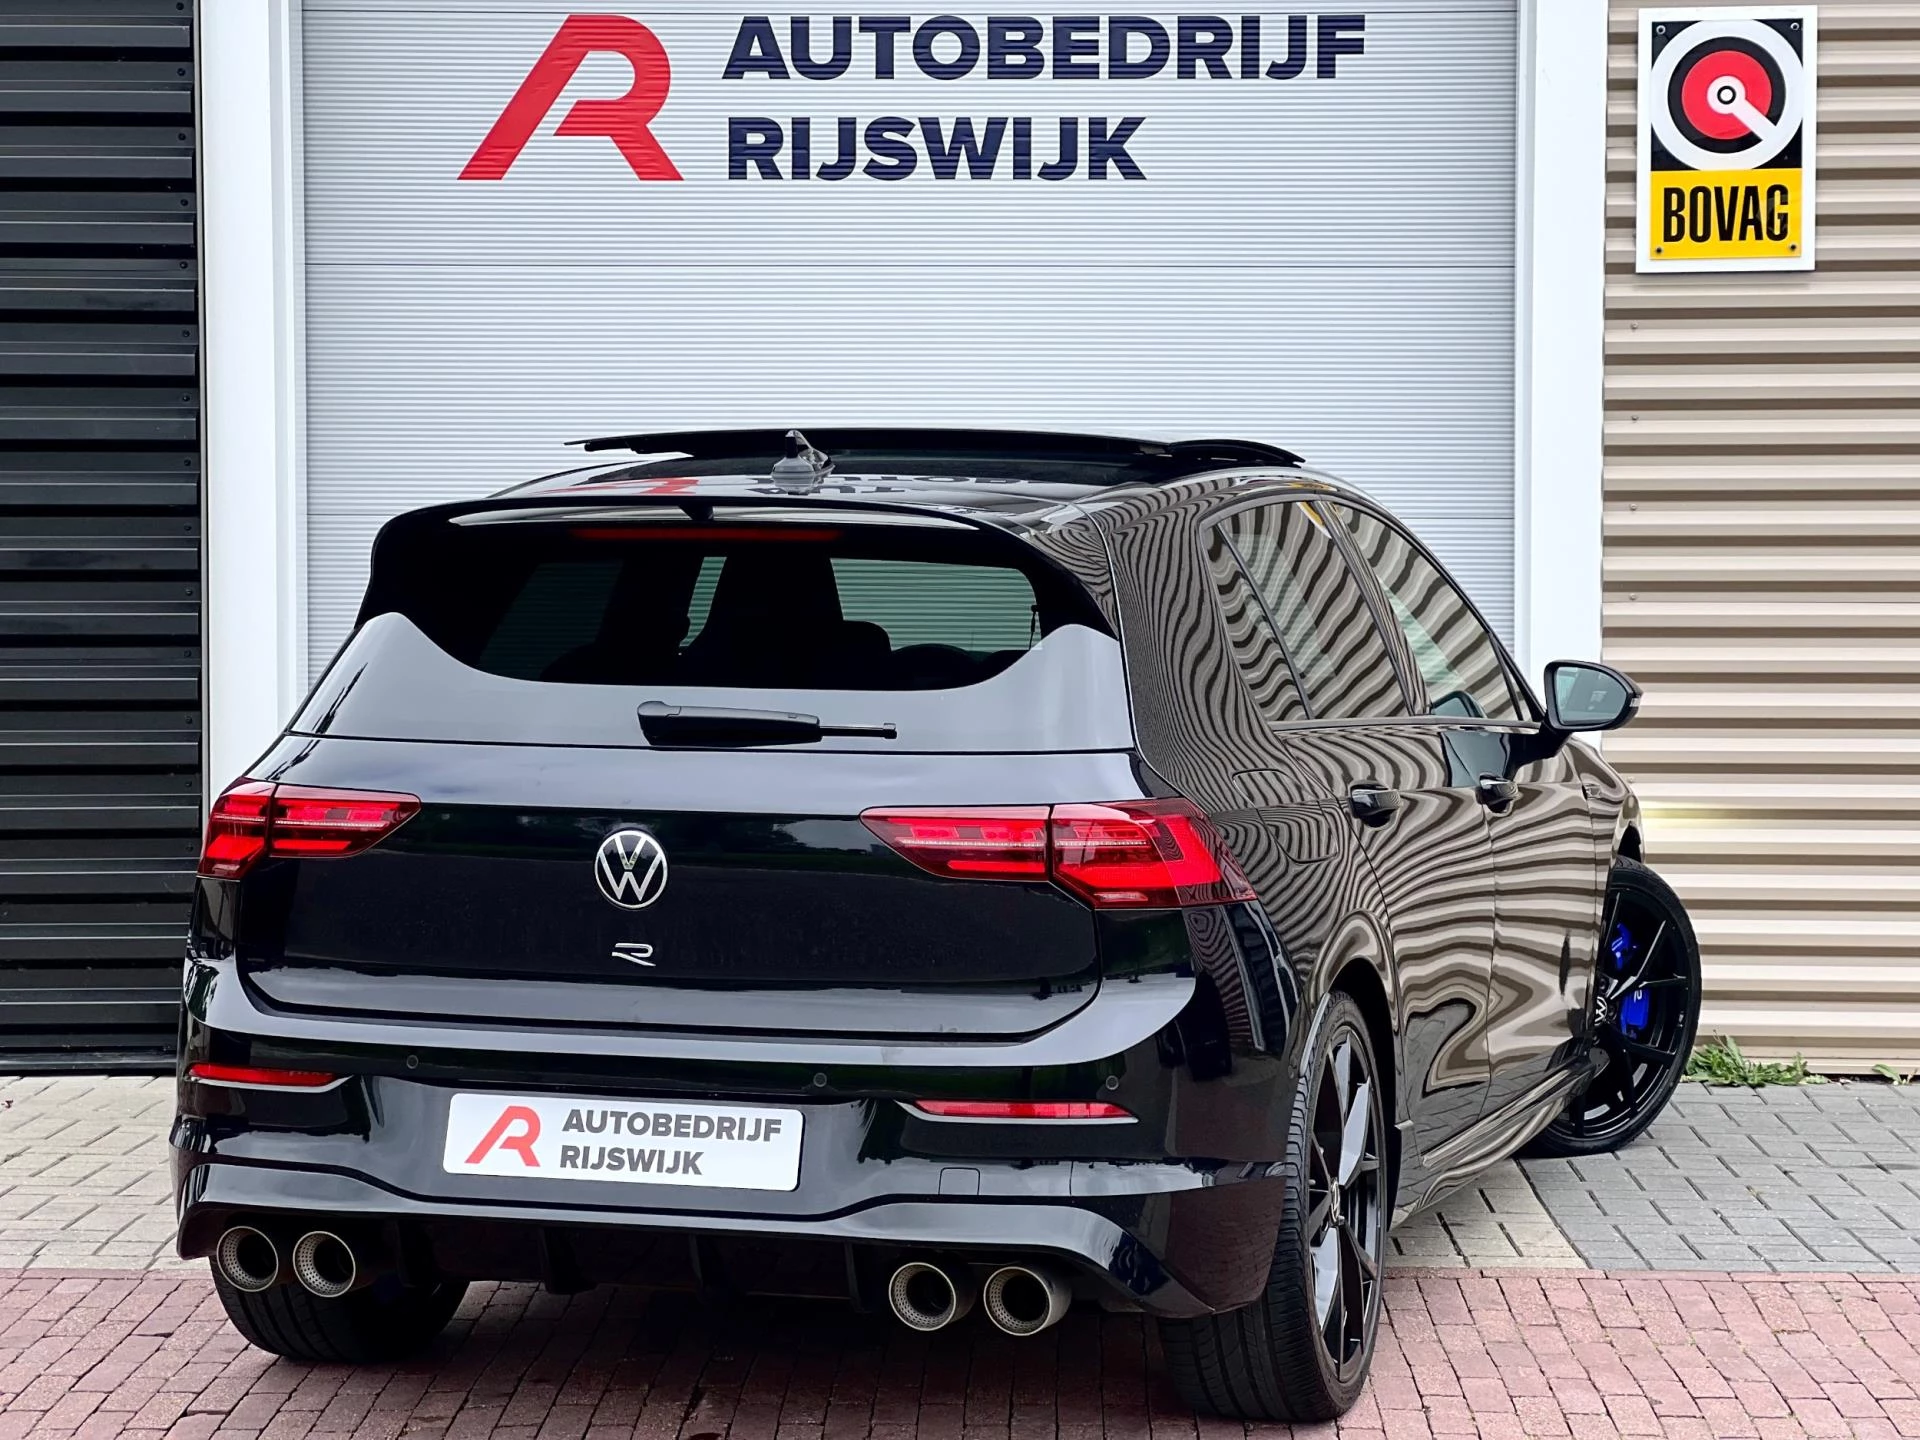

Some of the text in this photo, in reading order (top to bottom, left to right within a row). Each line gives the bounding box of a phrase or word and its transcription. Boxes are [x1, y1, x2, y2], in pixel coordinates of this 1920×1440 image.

[722, 15, 1365, 80] AUTOBEDRIJF
[728, 117, 1147, 181] RIJSWIJK
[1663, 184, 1789, 243] BOVAG
[561, 1108, 782, 1142] AUTOBEDRIJF
[560, 1145, 704, 1175] RIJSWIJK
